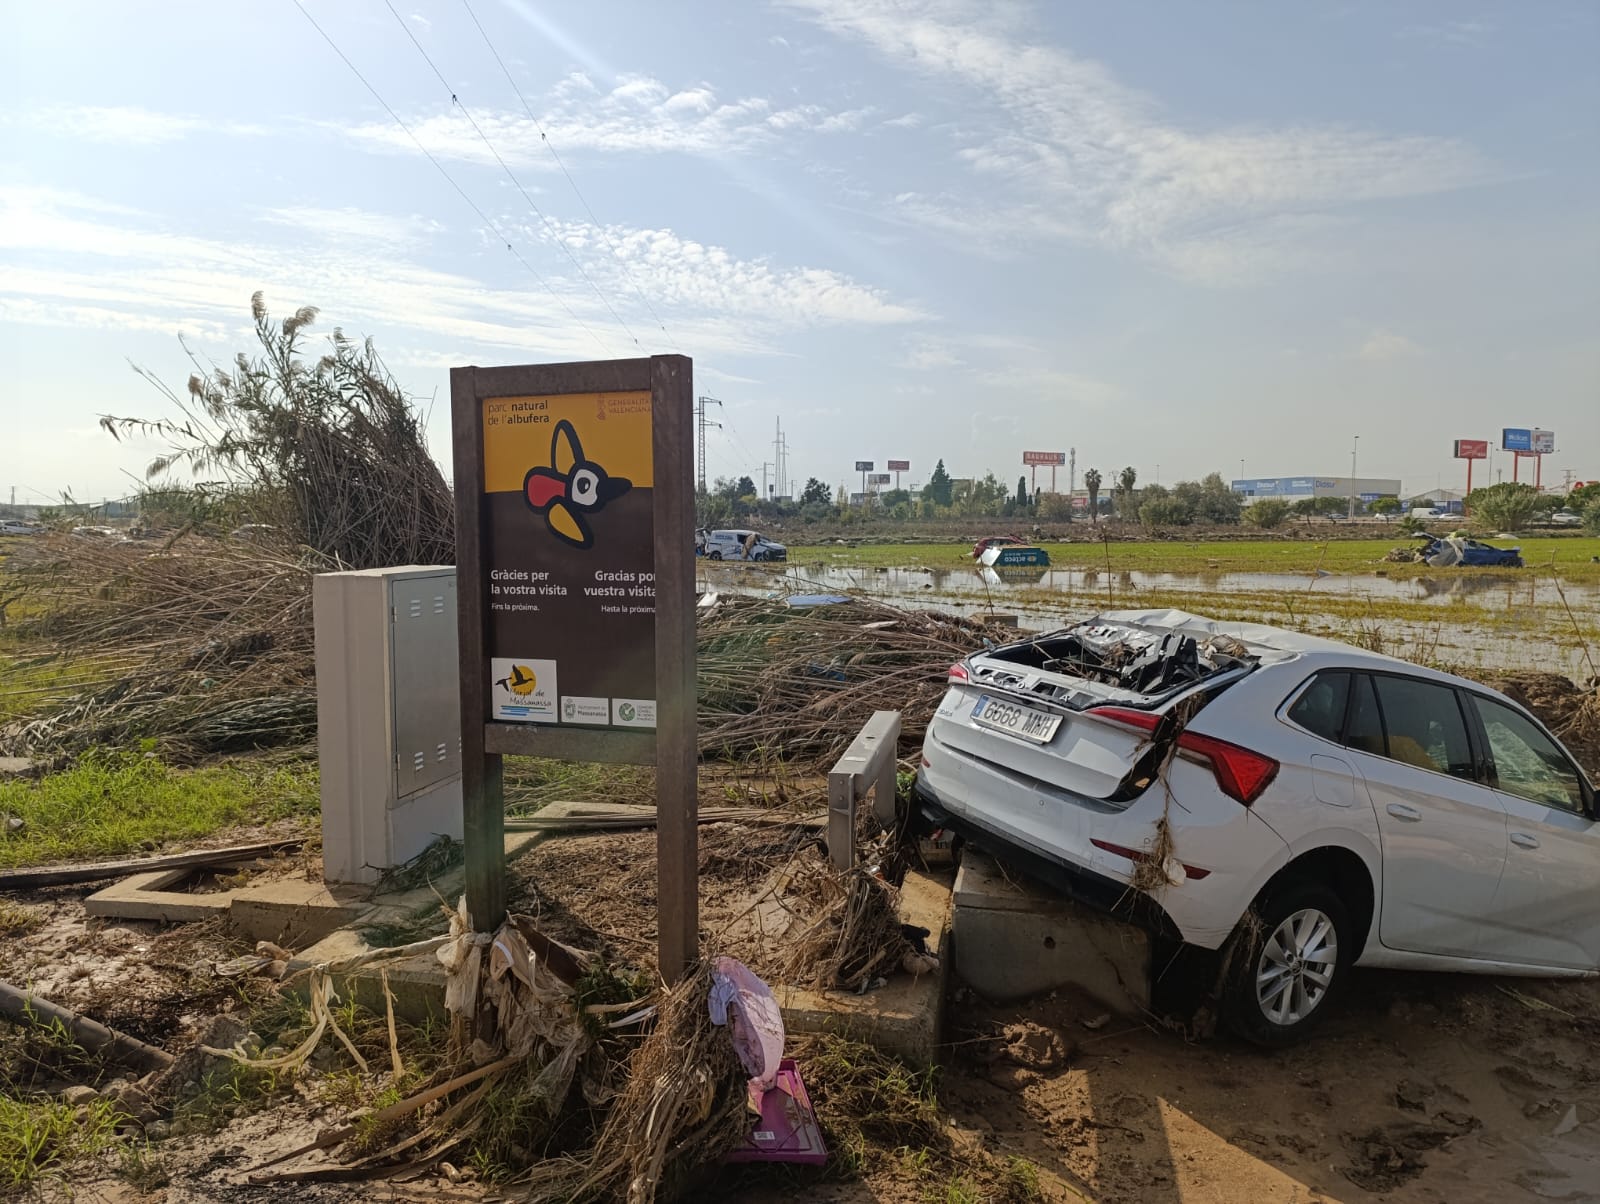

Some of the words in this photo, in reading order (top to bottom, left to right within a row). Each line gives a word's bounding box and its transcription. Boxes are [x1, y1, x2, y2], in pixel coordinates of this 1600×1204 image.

[488, 404, 507, 416] parc
[511, 400, 548, 412] natural
[488, 416, 499, 425] de
[502, 413, 550, 425] l'albufera
[490, 569, 529, 581] Gràcies
[531, 572, 550, 583] per
[595, 570, 636, 582] Gracias
[491, 584, 500, 595] la
[503, 585, 536, 595] vostra
[539, 584, 567, 596] visita
[584, 586, 625, 597] vuestra
[601, 604, 621, 613] Hasta
[621, 604, 628, 613] la
[984, 701, 1022, 727] 6668
